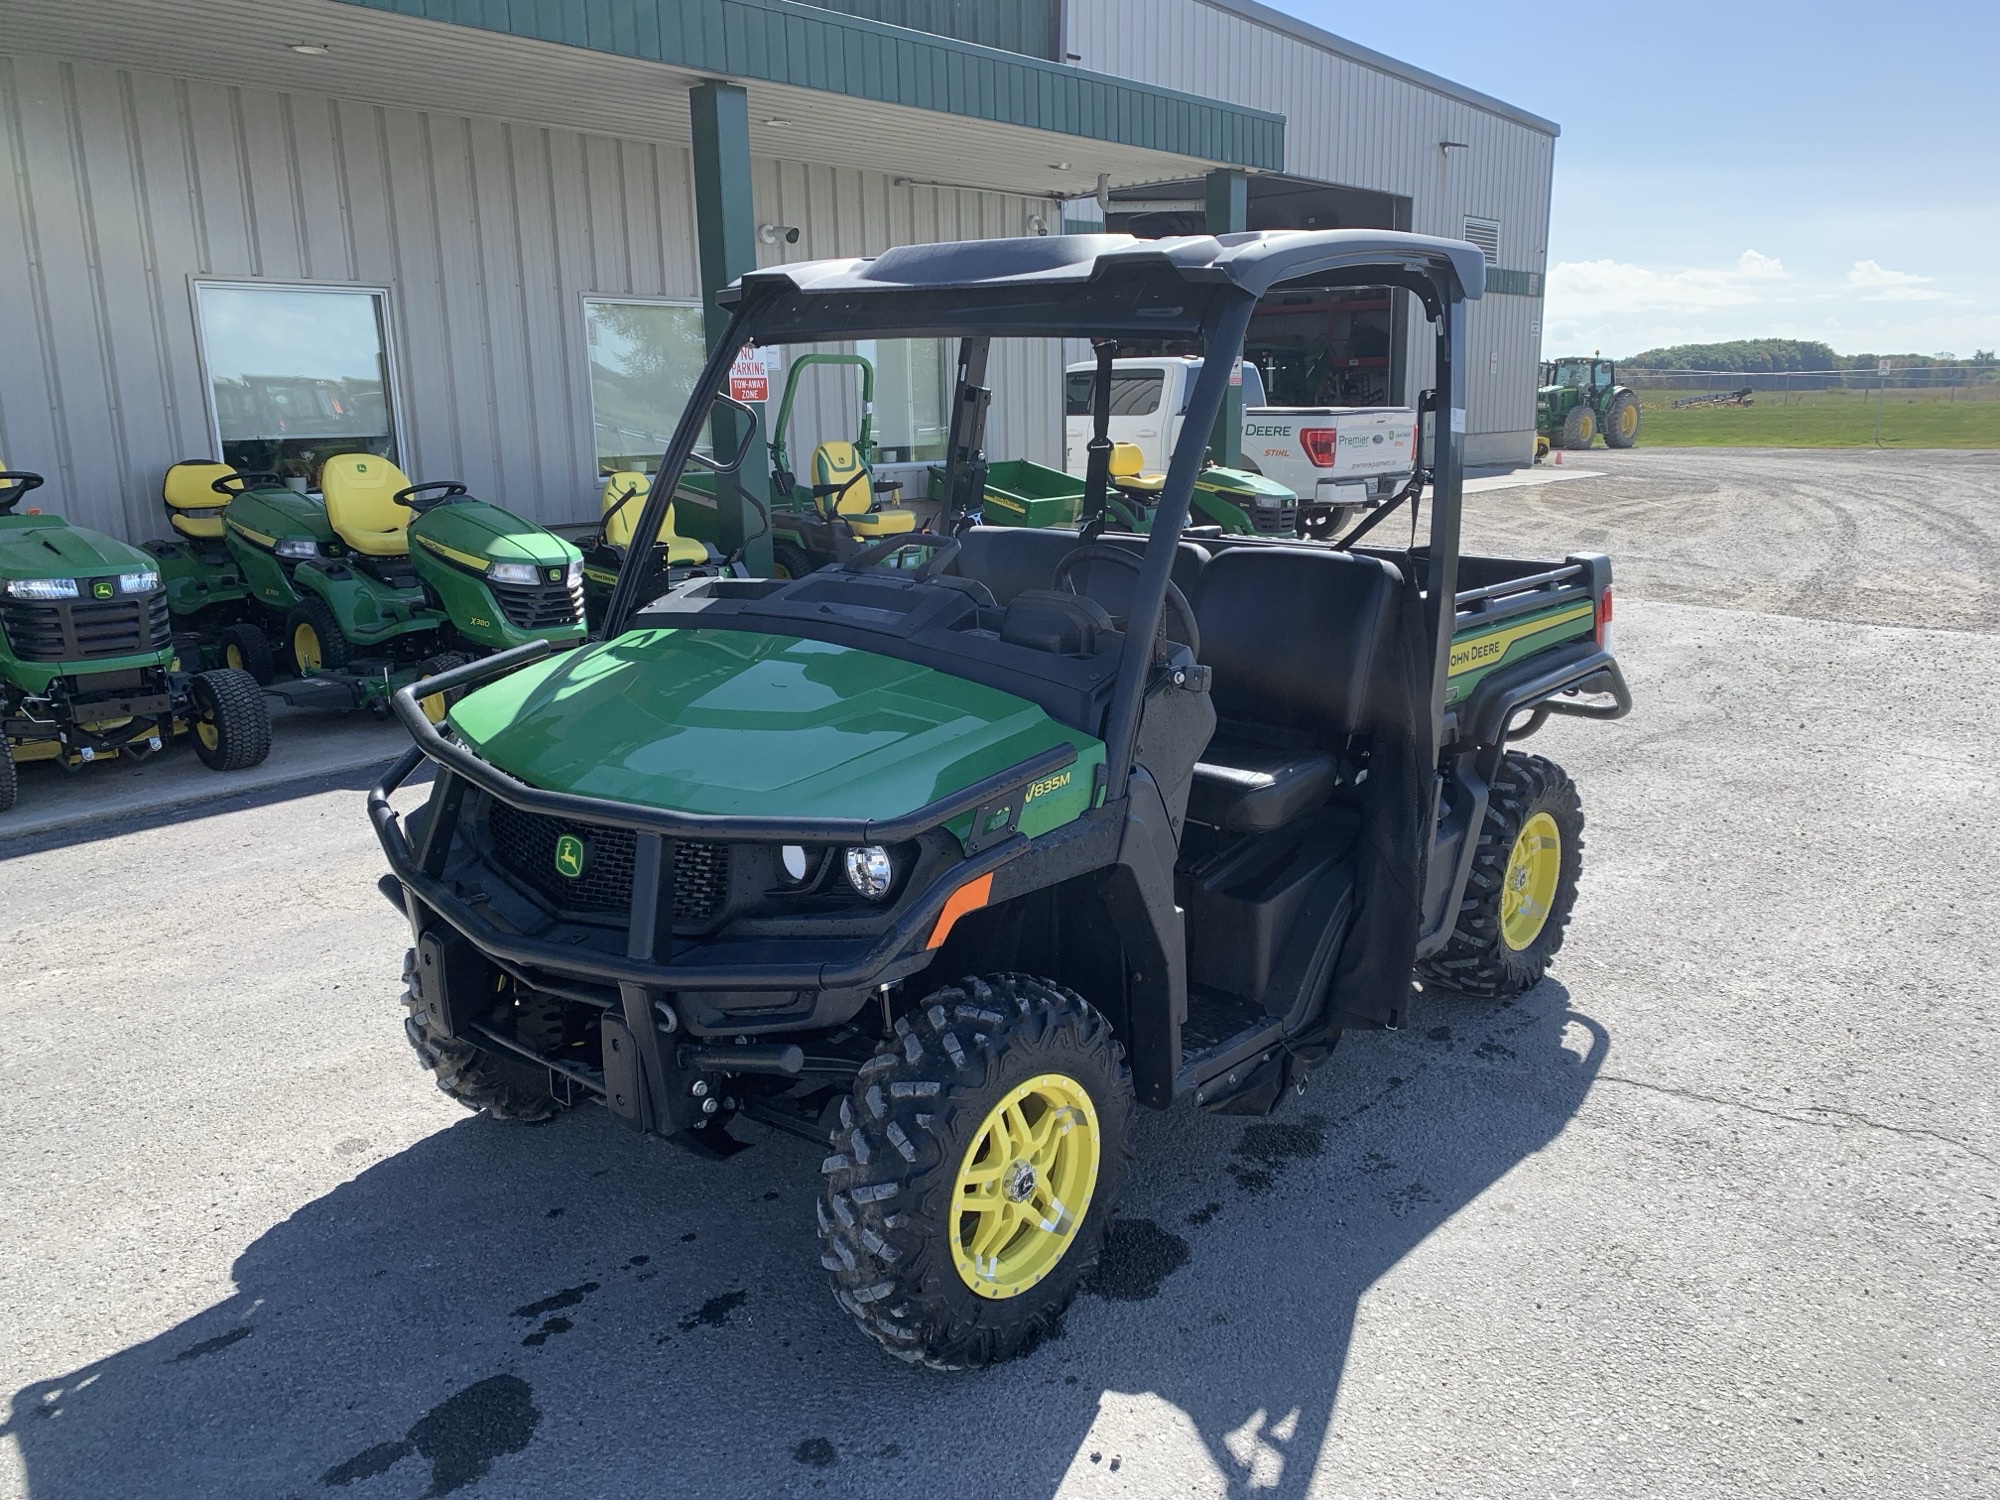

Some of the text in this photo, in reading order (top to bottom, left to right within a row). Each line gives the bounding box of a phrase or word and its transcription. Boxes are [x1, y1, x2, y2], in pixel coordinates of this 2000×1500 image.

[741, 347, 754, 360] NO
[732, 362, 765, 376] PARKING
[733, 380, 765, 389] TOW-AWAY
[741, 389, 759, 399] ZONE
[1245, 424, 1292, 437] DEERE
[1338, 435, 1370, 446] Premier
[1264, 449, 1290, 457] STIHL
[470, 617, 490, 627] X380
[1450, 641, 1500, 667] OHN DEERE
[1025, 771, 1071, 804] V835M
